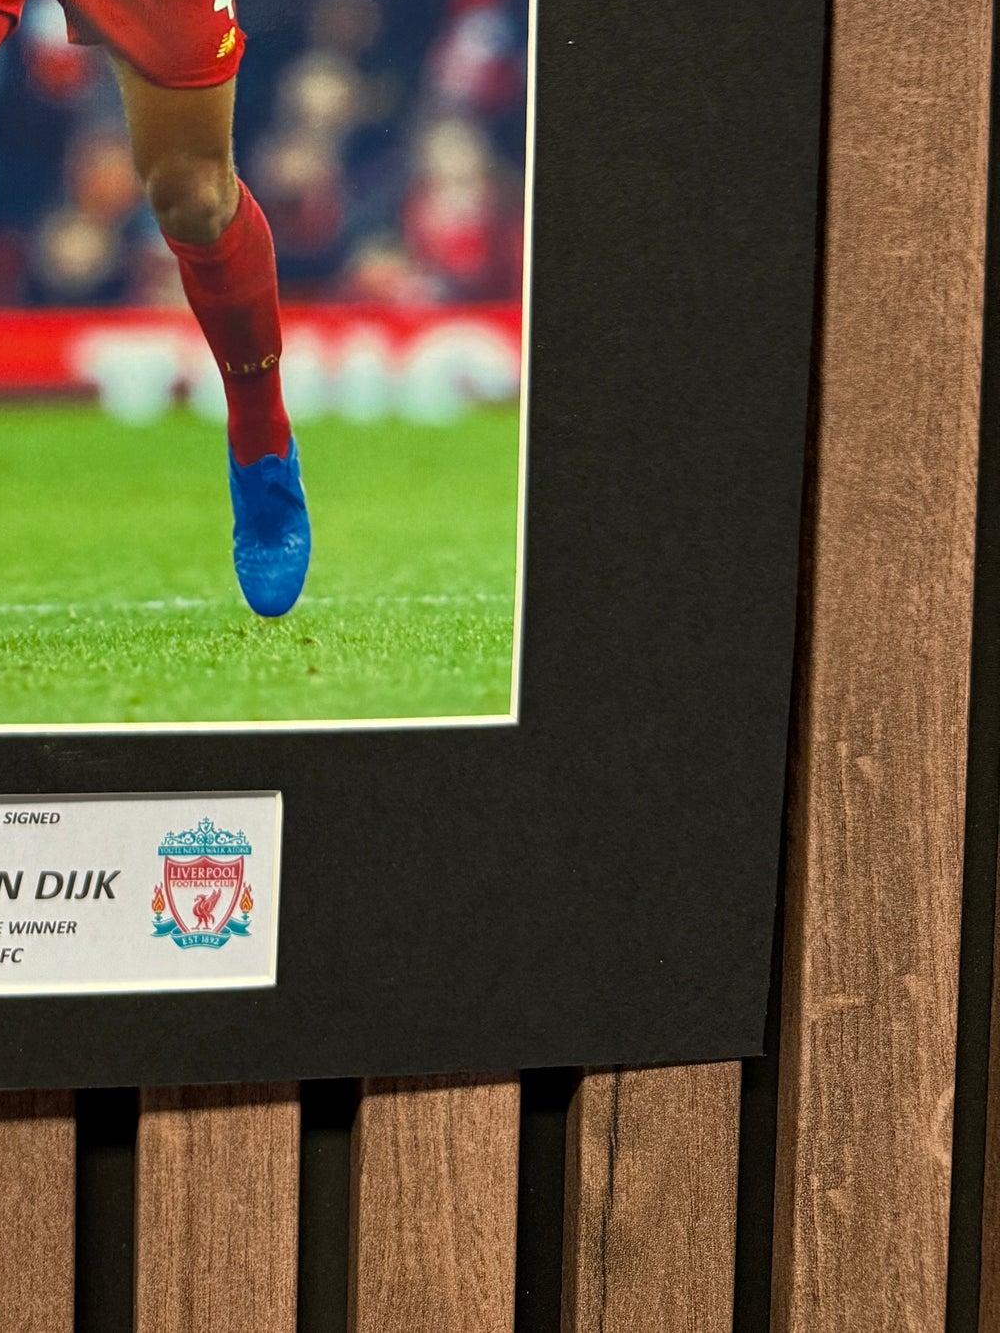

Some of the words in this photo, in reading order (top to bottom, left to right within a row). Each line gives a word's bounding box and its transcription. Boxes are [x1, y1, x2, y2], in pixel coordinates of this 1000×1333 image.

[3, 811, 61, 825] SIGNED
[170, 867, 238, 879] LIVERPOOL
[35, 870, 122, 900] DIJK
[173, 880, 212, 888] FOOTBALL
[215, 879, 235, 888] CLUB
[8, 920, 78, 935] WINNER
[0, 947, 24, 964] FC
